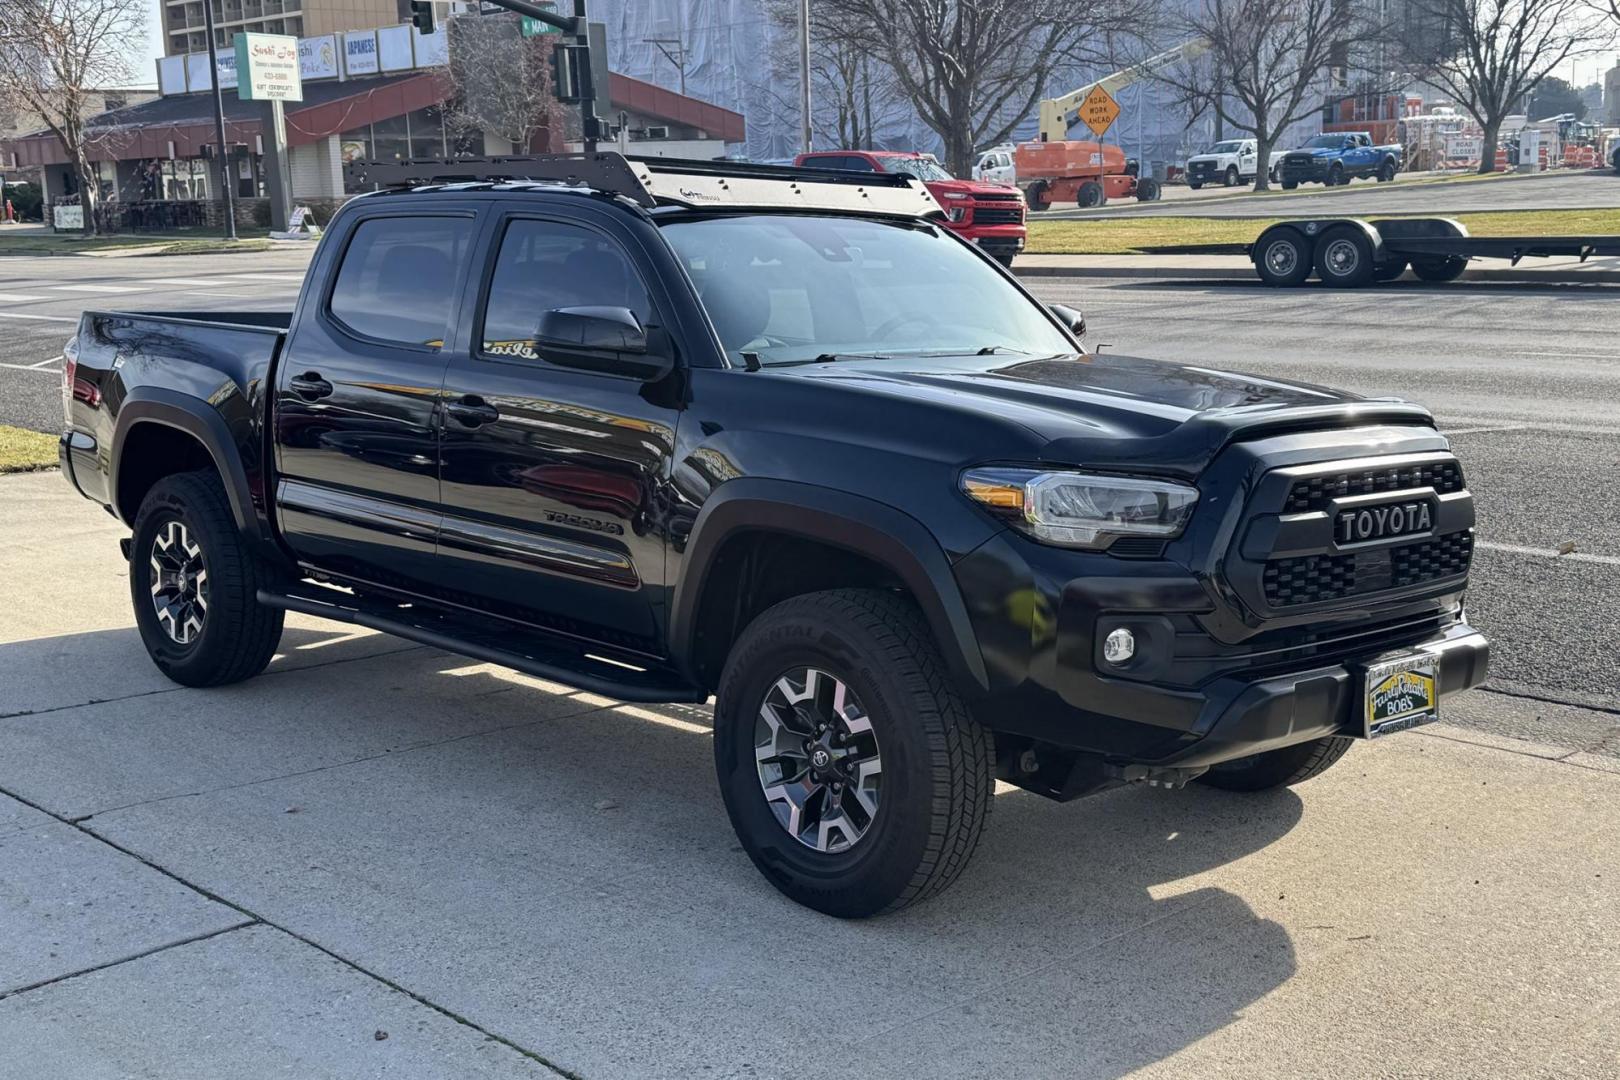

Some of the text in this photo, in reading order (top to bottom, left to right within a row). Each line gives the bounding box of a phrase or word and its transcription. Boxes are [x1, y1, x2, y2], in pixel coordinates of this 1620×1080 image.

[251, 44, 276, 57] Sushi
[347, 39, 376, 56] JAPANESE
[1089, 96, 1108, 104] ROAD
[1089, 106, 1107, 114] WORK
[1088, 116, 1111, 124] AHEAD
[1341, 503, 1431, 541] TOYOTA
[1370, 684, 1399, 713] Fairly
[1387, 695, 1413, 715] BOB'S
